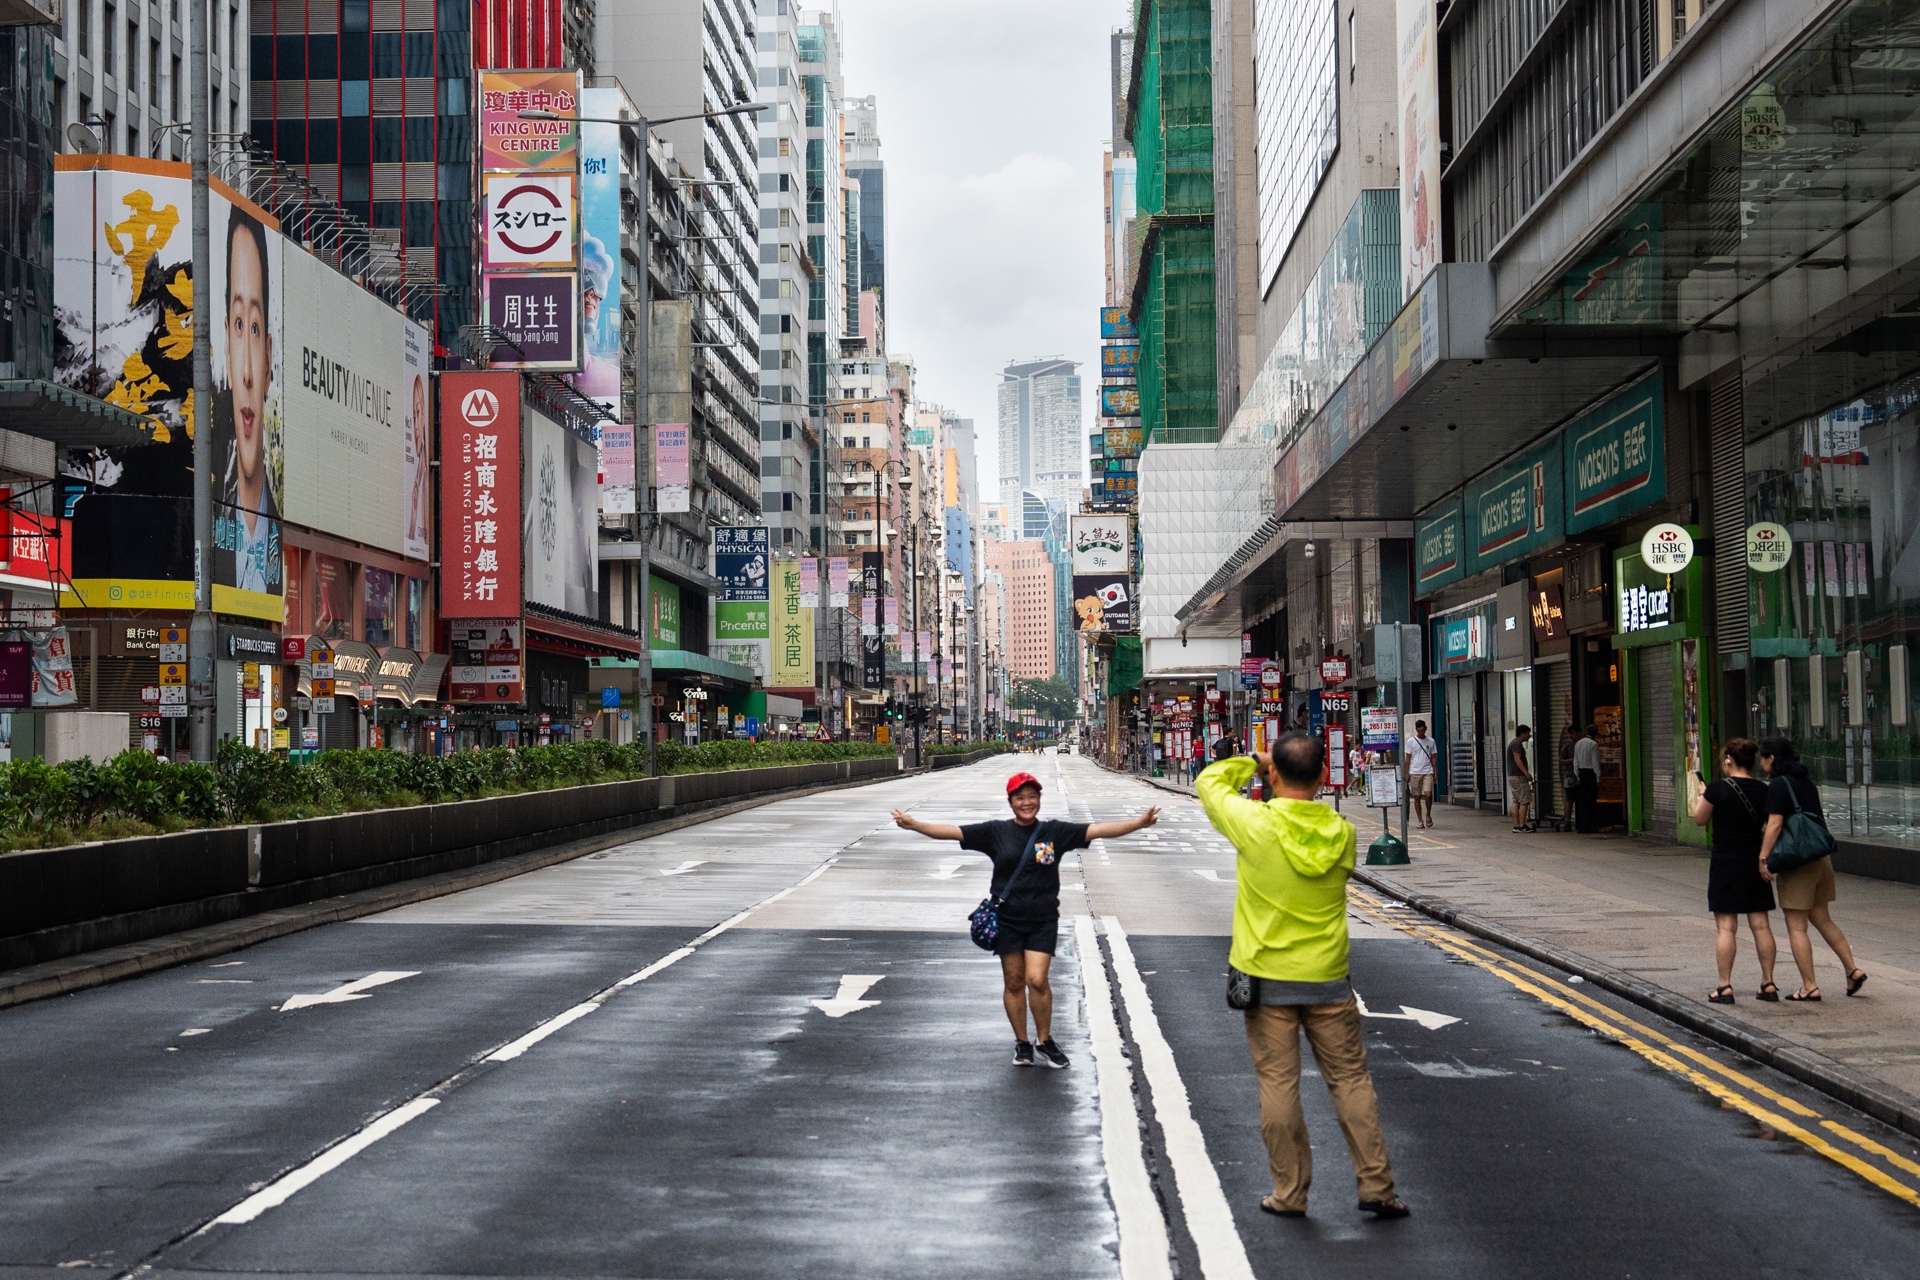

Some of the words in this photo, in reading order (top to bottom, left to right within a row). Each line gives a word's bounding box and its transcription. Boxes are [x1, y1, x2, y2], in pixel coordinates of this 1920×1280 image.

[484, 90, 576, 112] 瓊華中心
[490, 122, 529, 135] KING
[533, 122, 570, 134] WAH
[501, 139, 560, 151] CENTRE
[584, 158, 607, 175] 你!
[492, 210, 567, 231] スシロー
[503, 295, 559, 329] 周生生
[523, 329, 541, 345] Sang
[541, 329, 559, 344] Sang
[303, 345, 350, 407] BEAUTY
[350, 372, 392, 428] AVENUE
[462, 433, 471, 463] CMB
[1579, 439, 1620, 492] watsons
[463, 470, 472, 508] WING
[474, 432, 499, 601] 招商永隆銀行
[1480, 499, 1509, 538] watsons
[463, 515, 472, 554] LUNG
[717, 529, 767, 543] 舒適堡
[716, 545, 767, 553] PHYSICAL
[1651, 543, 1687, 553] HSBC
[1093, 556, 1108, 568] 3/F
[463, 561, 472, 601] BANK
[746, 611, 767, 621] 實惠
[454, 620, 492, 628] sincere
[720, 620, 767, 631] Pricerite
[126, 628, 159, 639] 銀行中
[126, 641, 144, 649] Bank
[145, 641, 160, 649] Cen
[177, 644, 183, 652] 7
[237, 637, 261, 653] STARBUCKS
[261, 641, 276, 654] COFFEE
[1261, 702, 1283, 713] N64
[1321, 698, 1349, 711] N65
[140, 717, 161, 728] S16
